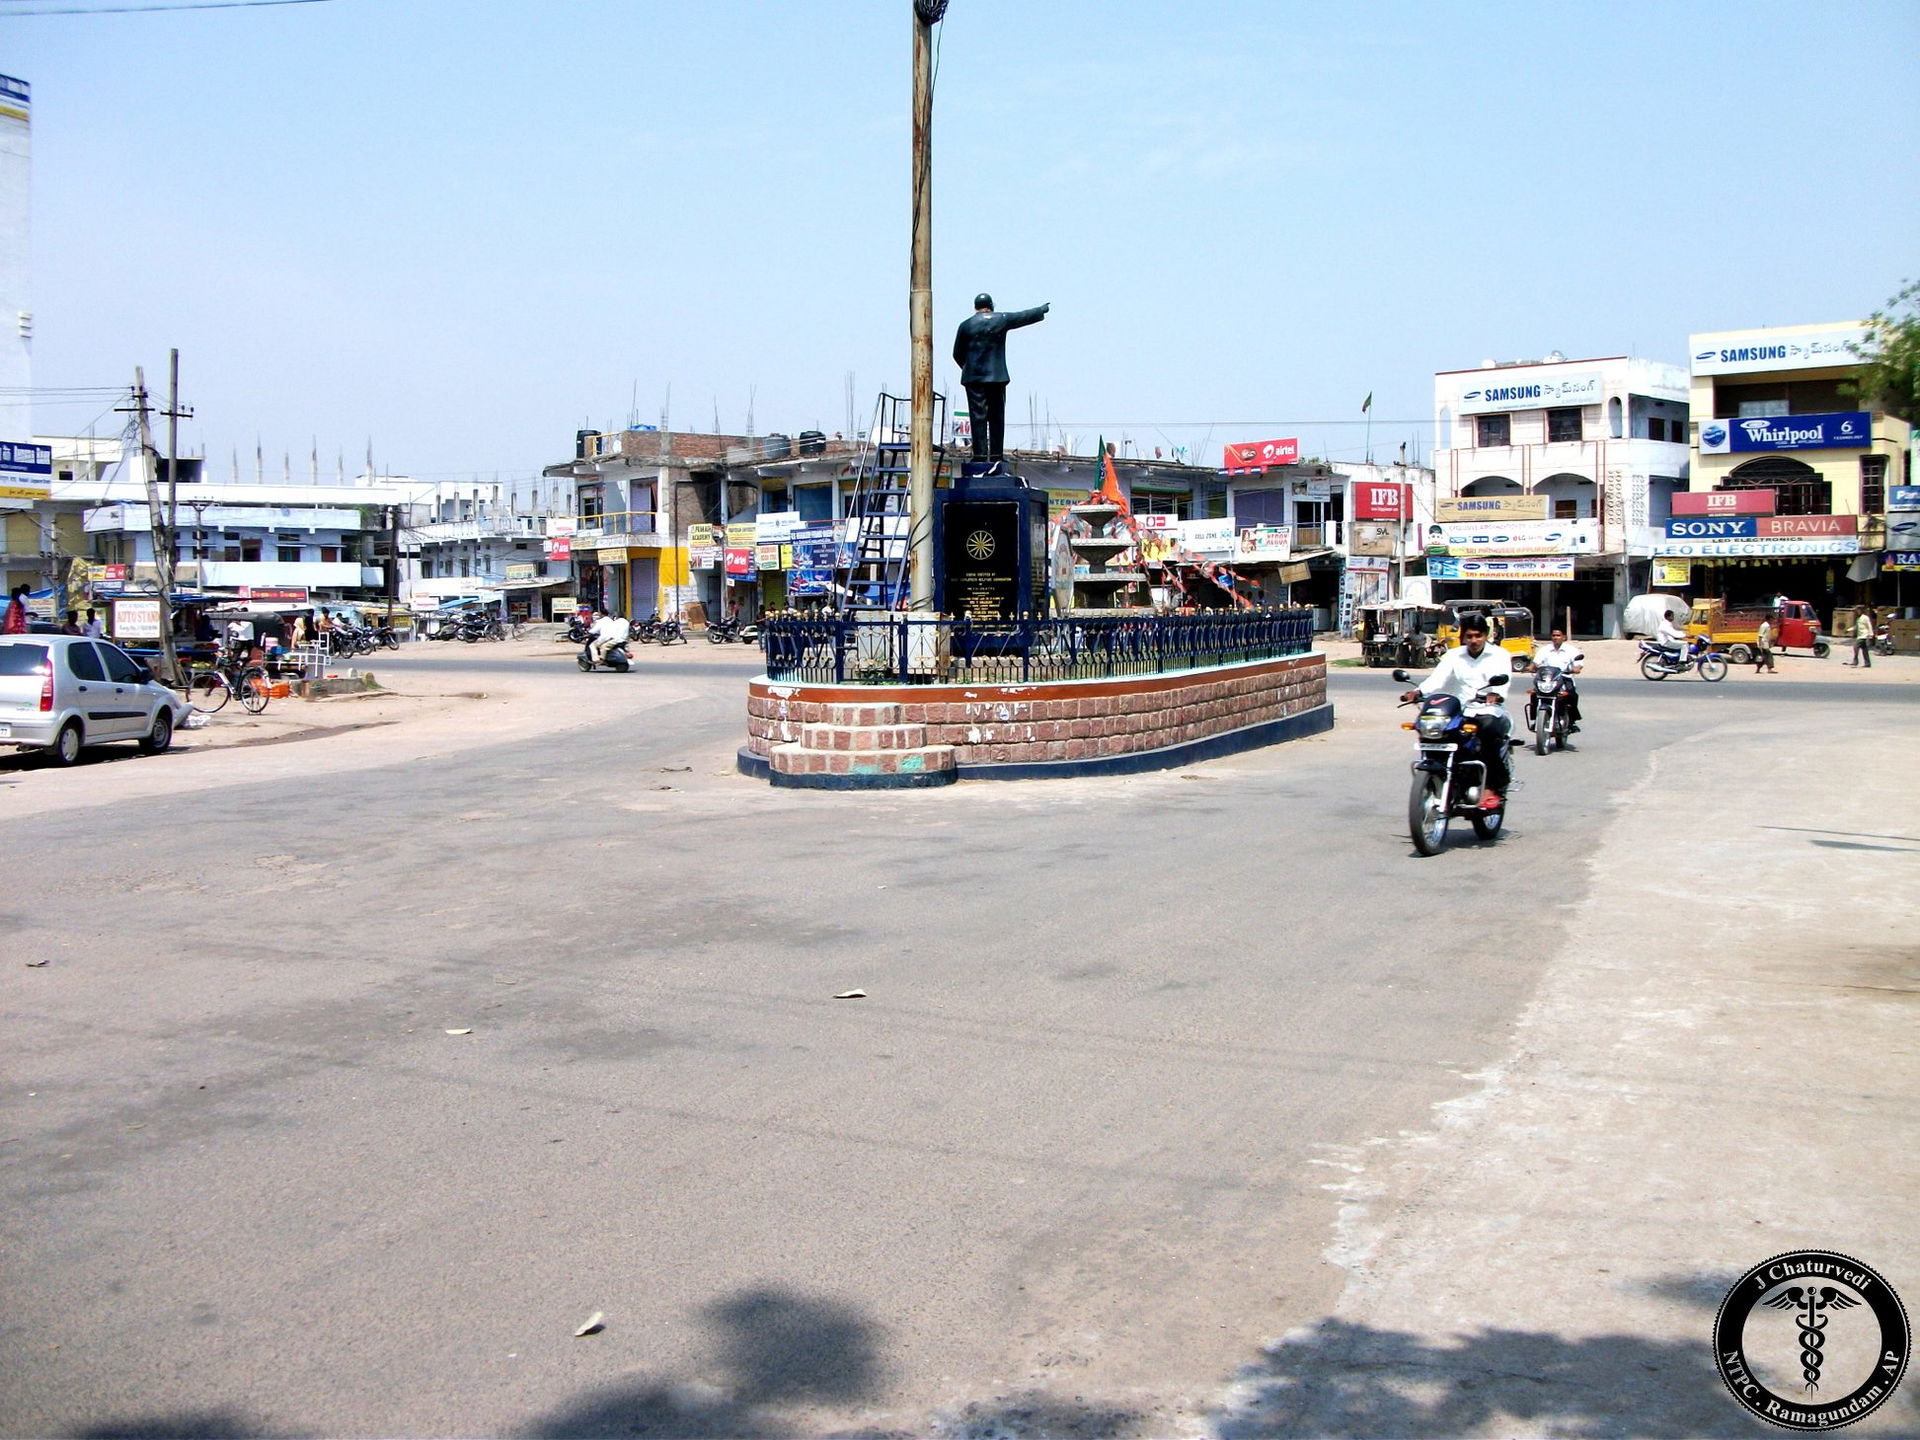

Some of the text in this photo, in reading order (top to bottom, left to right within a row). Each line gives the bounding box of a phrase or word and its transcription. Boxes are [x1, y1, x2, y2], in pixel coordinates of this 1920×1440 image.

[1721, 345, 1786, 363] SAMSUNG
[1485, 385, 1541, 401] SAMSUNG
[1747, 425, 1823, 445] Whirlpool
[1275, 445, 1295, 456] airtel
[1370, 488, 1399, 506] IFB
[1707, 494, 1736, 507] IFB
[1457, 500, 1501, 511] SAMSUNG
[1671, 520, 1841, 536] SONY BRAVIA
[1653, 540, 1858, 556] LEO ELECTRONICS
[733, 555, 746, 565] airtel
[1896, 553, 1920, 564] RA
[117, 611, 159, 623] AUTO STAND
